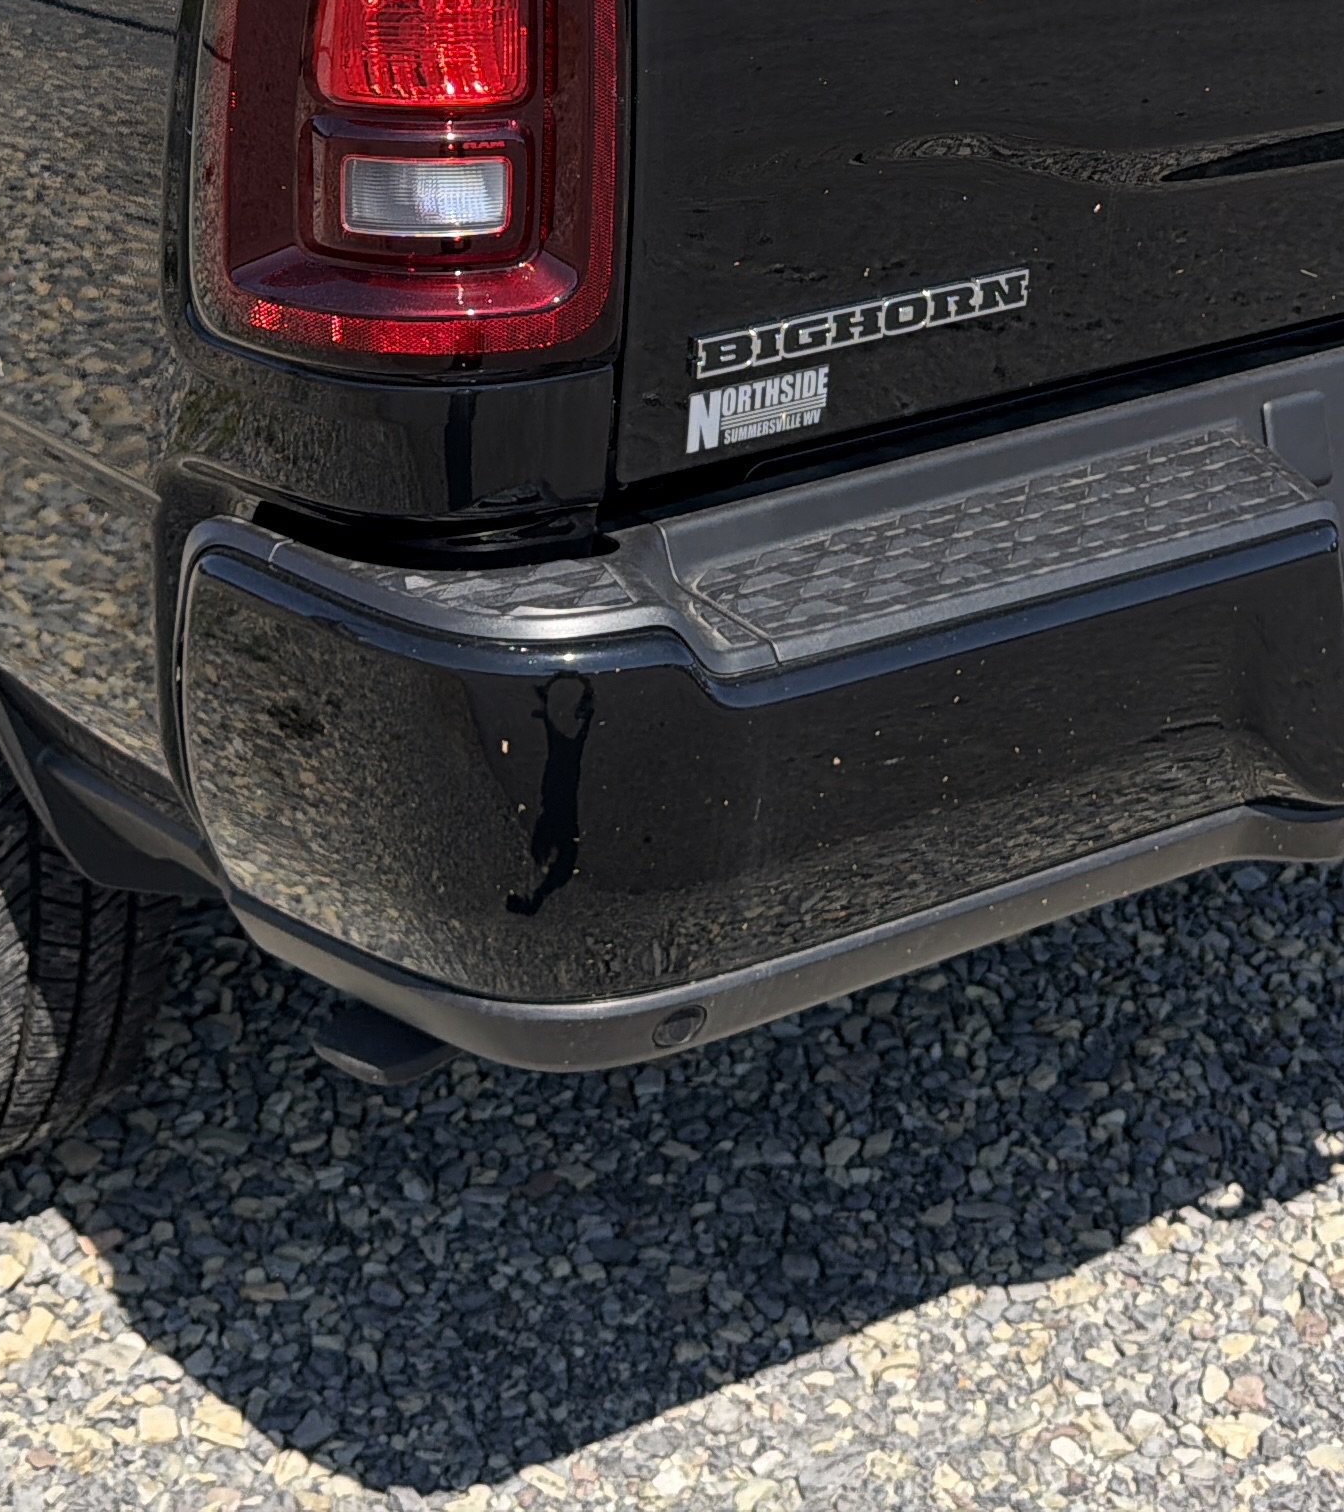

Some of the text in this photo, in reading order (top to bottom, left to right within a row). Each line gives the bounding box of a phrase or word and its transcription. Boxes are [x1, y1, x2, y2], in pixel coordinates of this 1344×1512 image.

[463, 140, 506, 150] RAM
[694, 267, 1030, 380] BIGHORN
[686, 365, 830, 455] NORTHSIDE
[723, 408, 822, 445] SUMMERSVILLE WV
